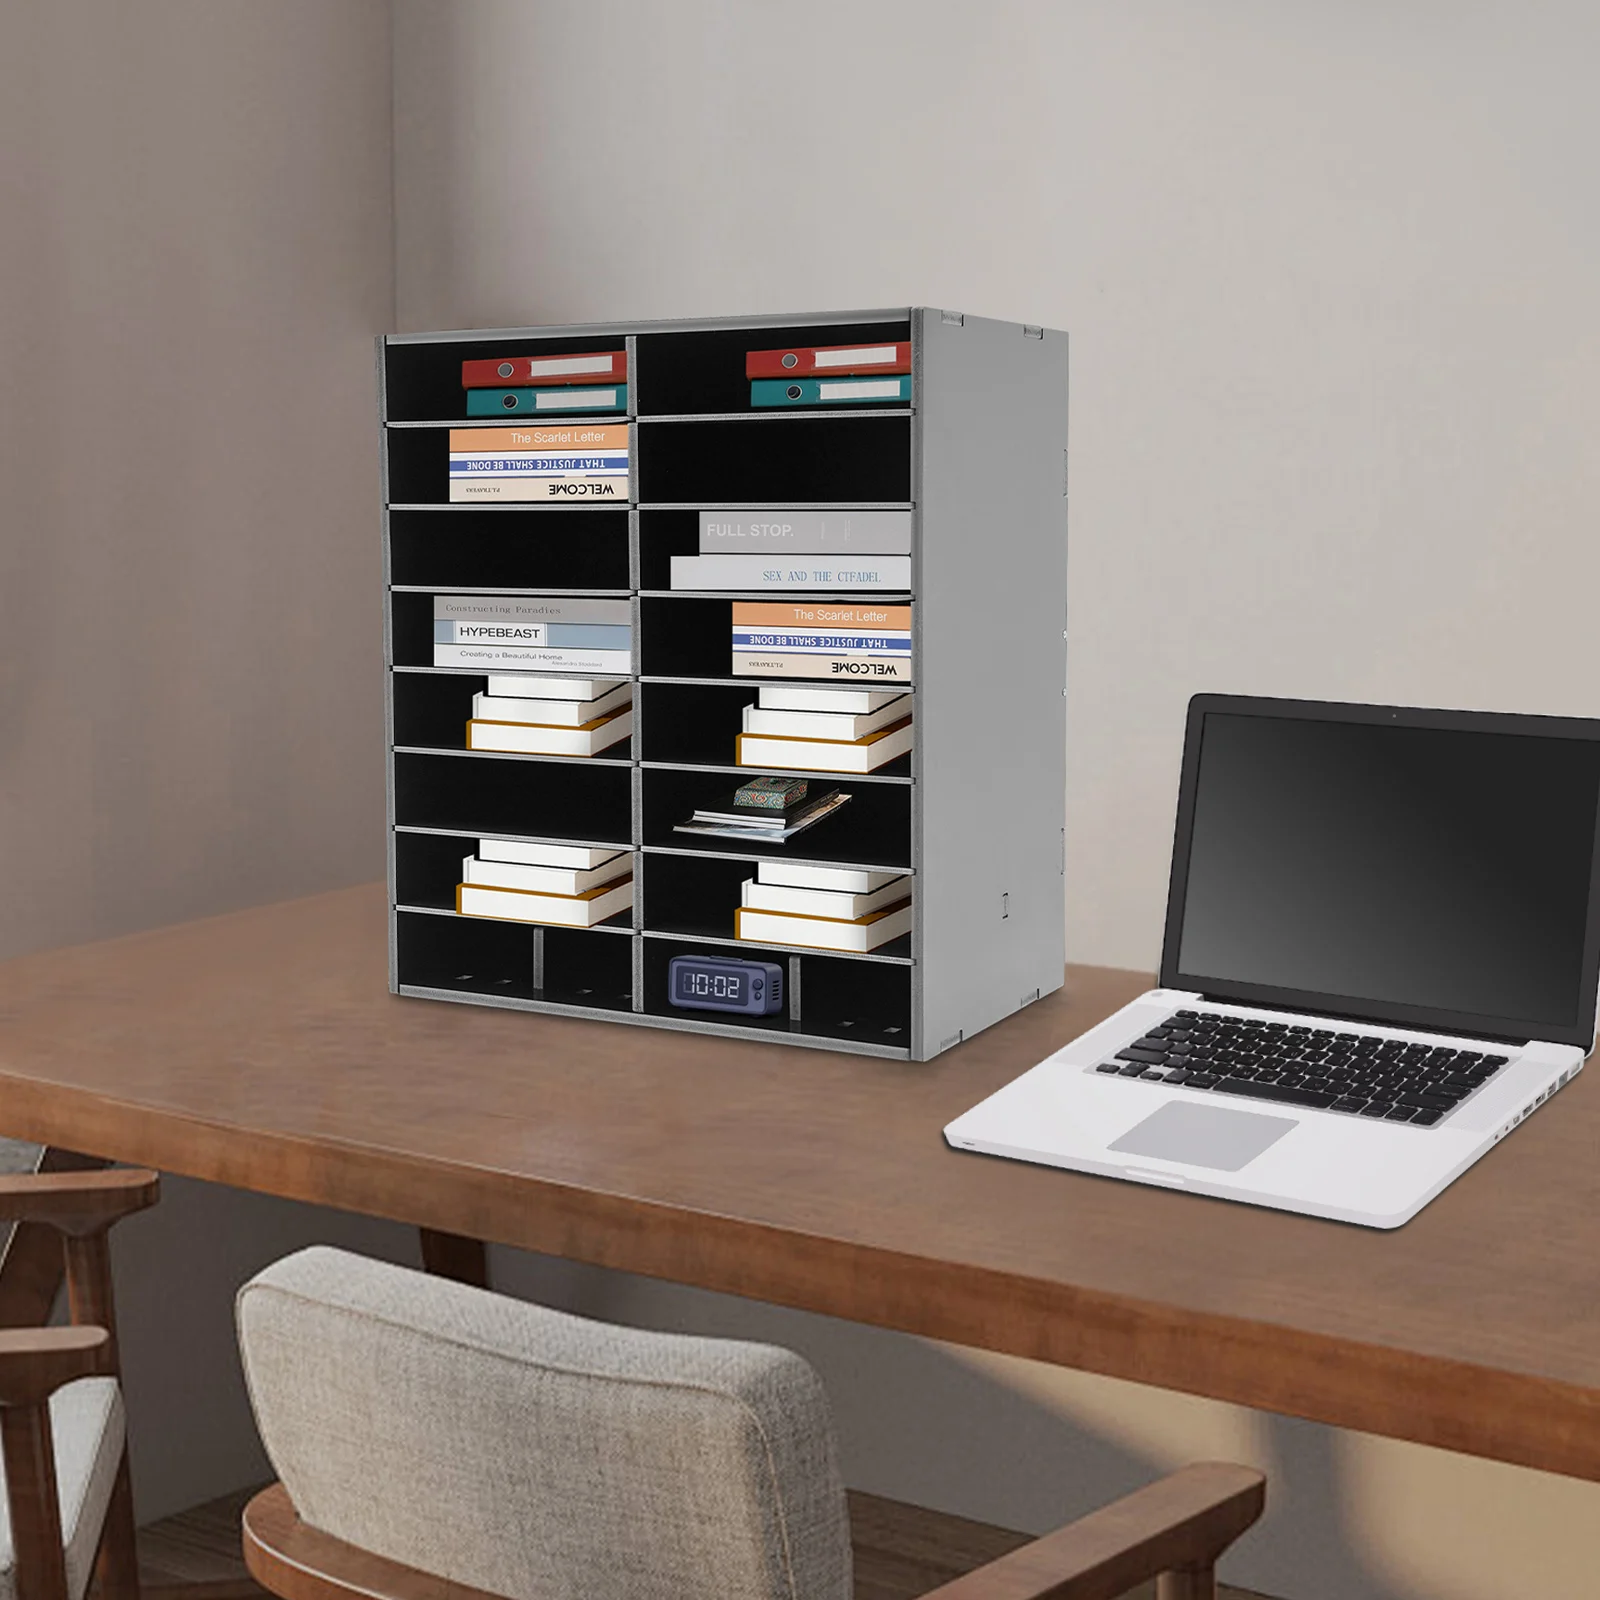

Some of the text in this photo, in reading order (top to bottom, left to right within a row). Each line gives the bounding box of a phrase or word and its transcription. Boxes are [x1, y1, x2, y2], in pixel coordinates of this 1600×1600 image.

[511, 432, 605, 443] The Scarlet Letter
[467, 459, 605, 470] THAT JUSTICE SHALL BE DONE
[549, 484, 614, 495] WELCOME
[706, 523, 794, 537] FULL STOP.
[763, 570, 782, 582] SEX
[788, 571, 807, 582] AND
[813, 571, 832, 582] THE
[445, 604, 561, 615] Constructing Paradies
[794, 608, 888, 622] The Scarlet Letter
[460, 626, 540, 639] HYPEBEAST
[749, 635, 888, 649] THAT JUSTICE SHALL BE DONE
[460, 650, 493, 659] Creating
[501, 651, 537, 660] Beautiful
[538, 653, 563, 661] Home
[832, 662, 897, 675] WELCOME
[691, 973, 740, 998] 10:02
